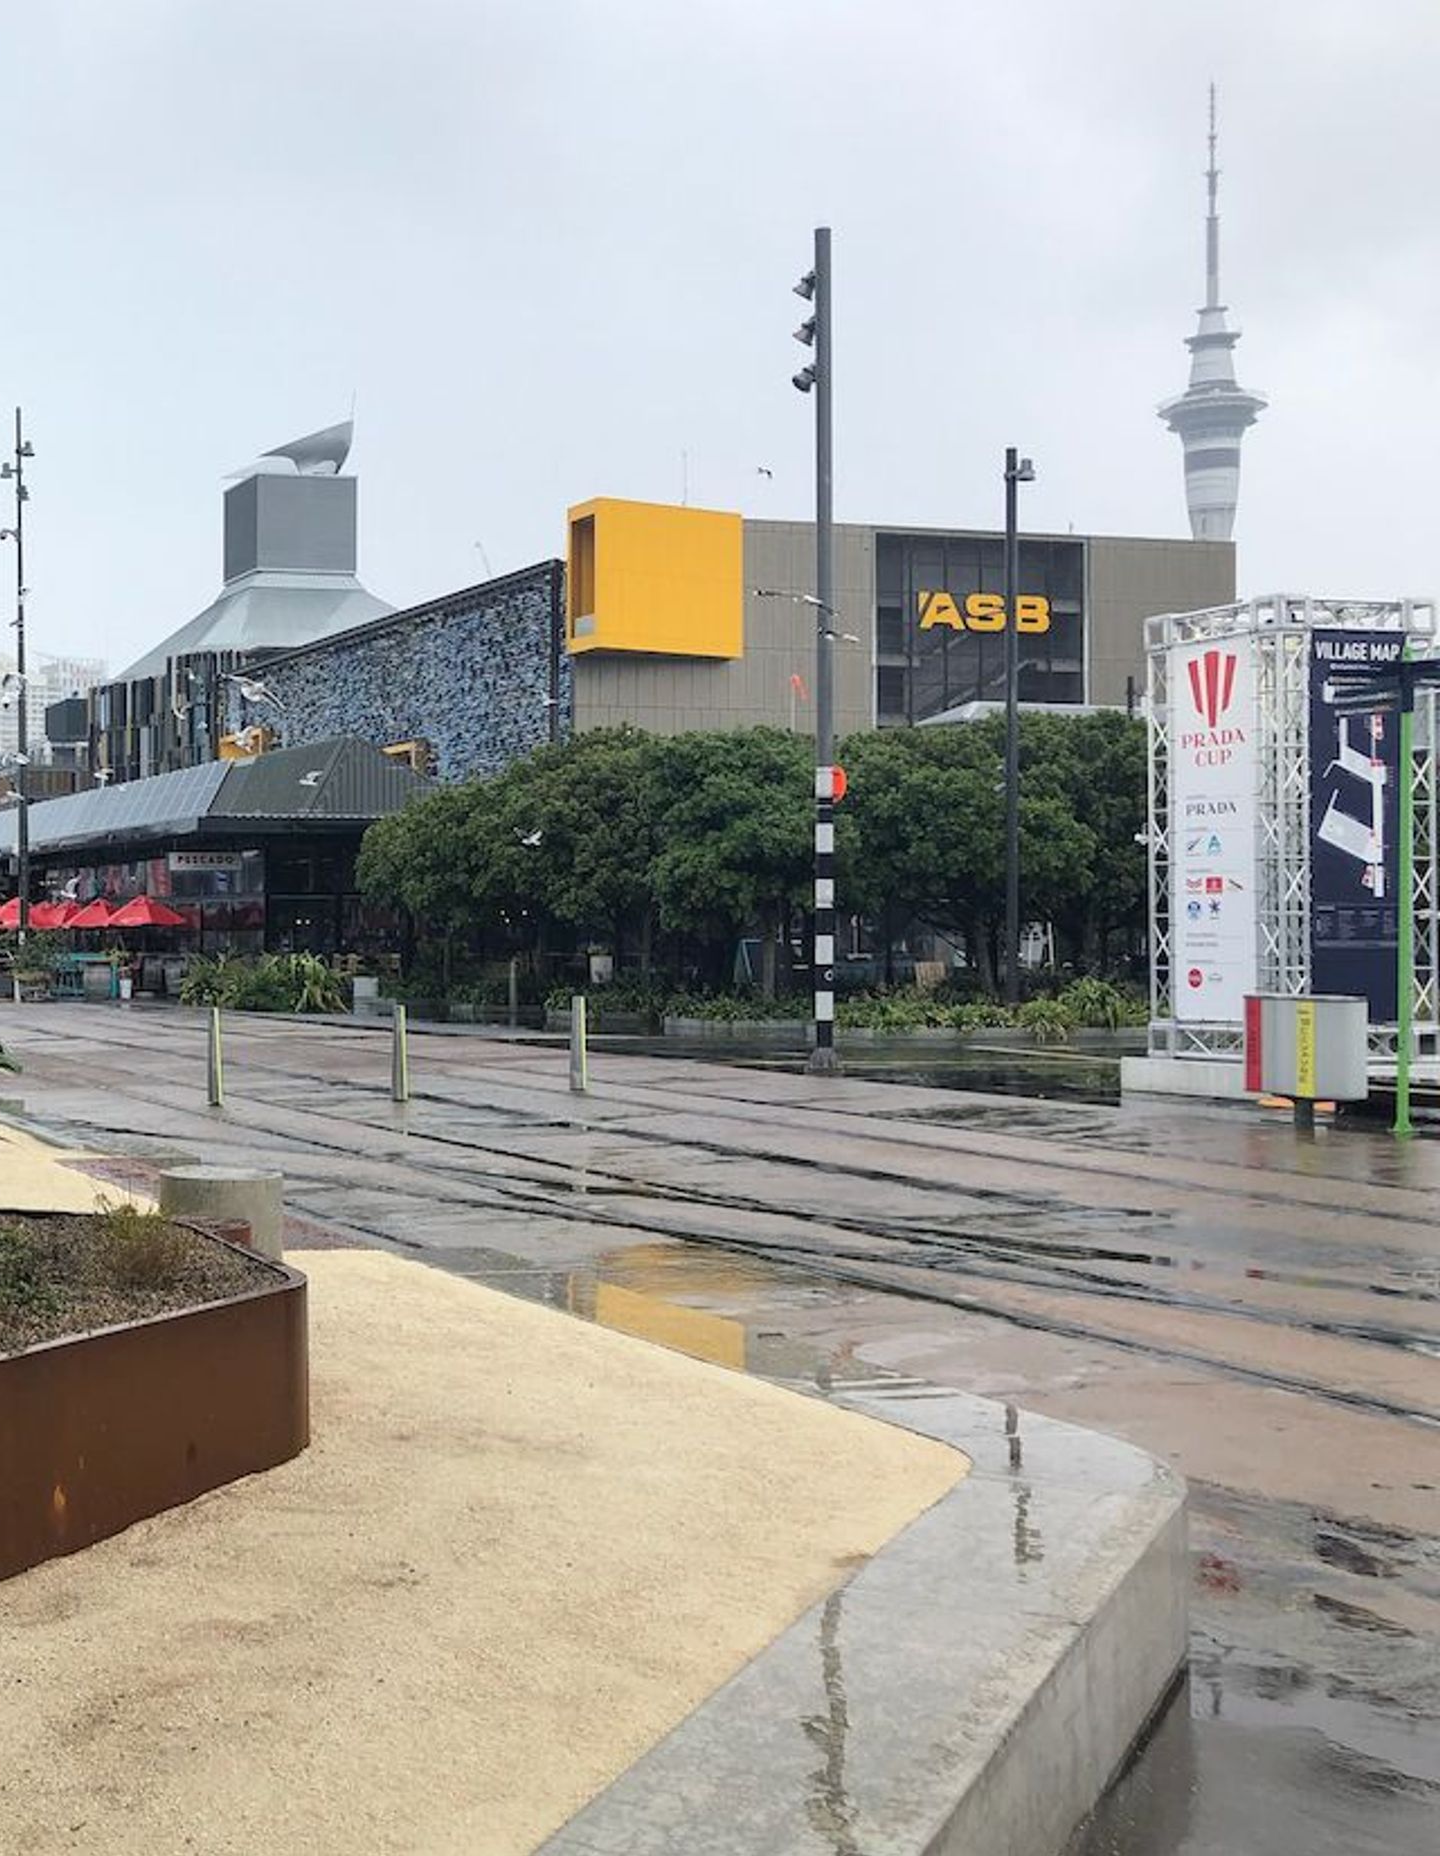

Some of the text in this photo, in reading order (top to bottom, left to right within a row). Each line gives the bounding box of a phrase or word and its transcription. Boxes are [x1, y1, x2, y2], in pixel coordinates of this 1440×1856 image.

[918, 591, 1052, 633] ASB
[1314, 641, 1401, 662] VILLAGE MAP
[1181, 728, 1246, 749] PRADA
[1194, 748, 1232, 767] CUP
[1185, 801, 1237, 816] PRADA
